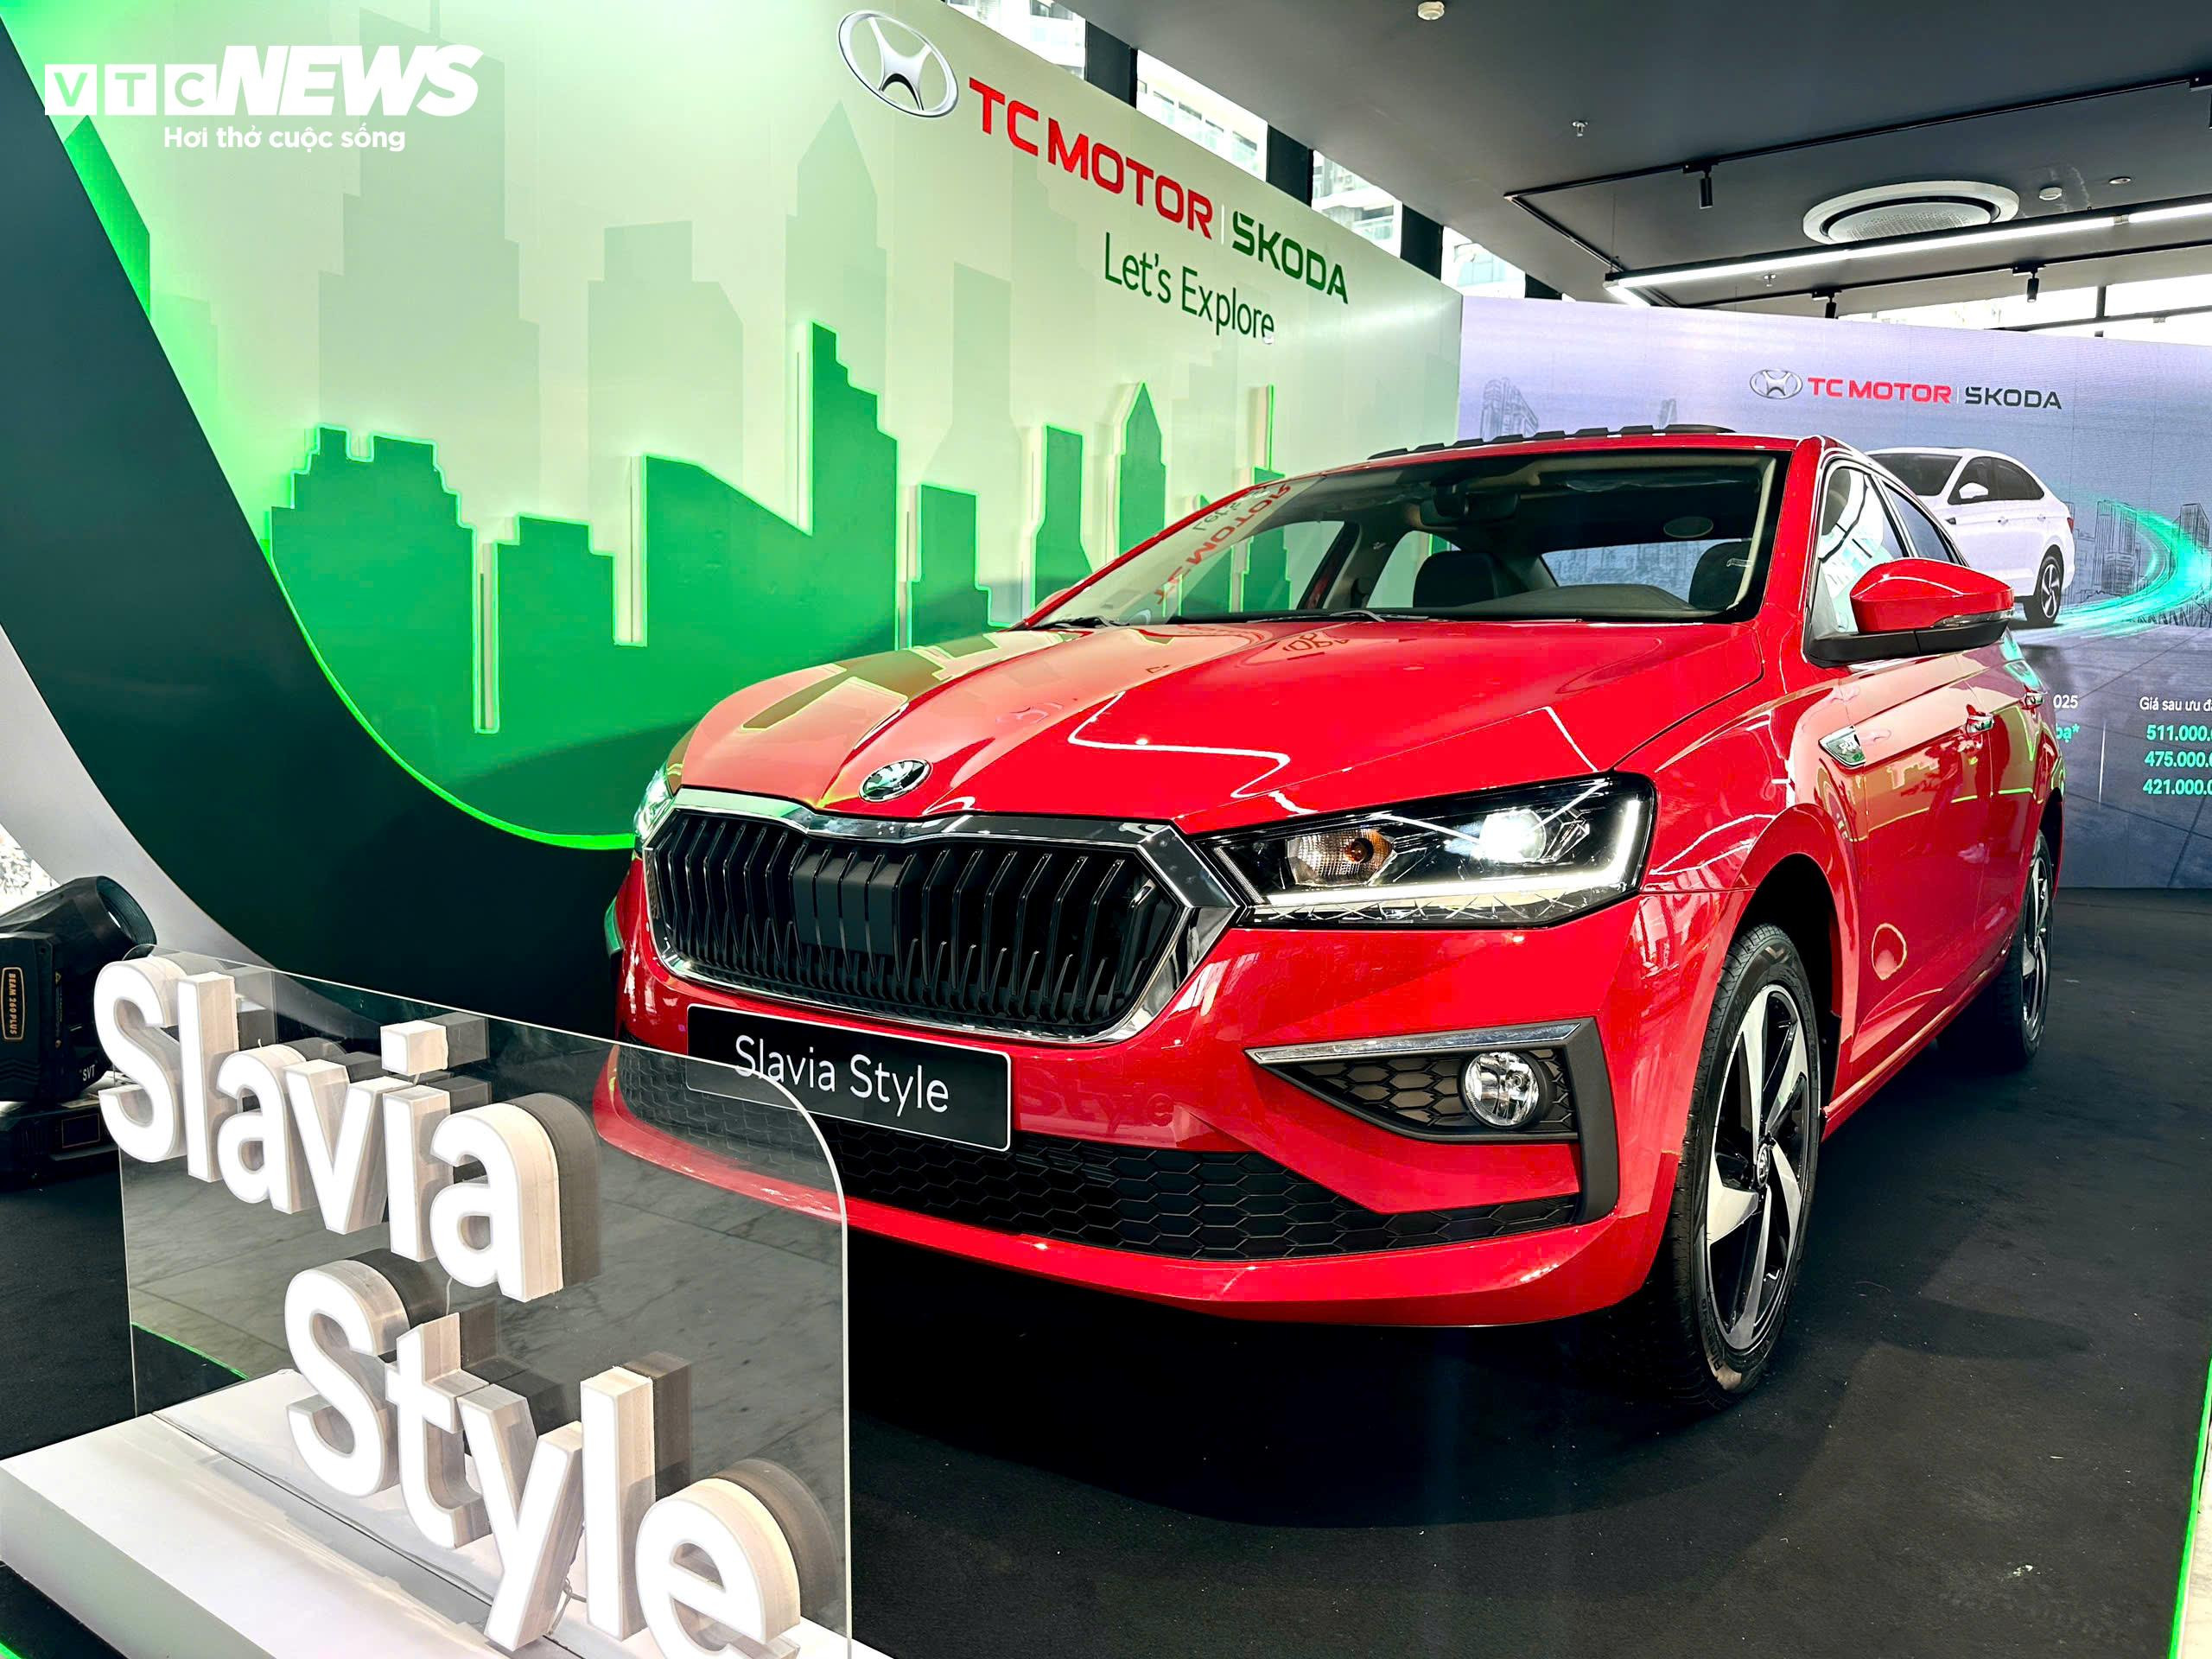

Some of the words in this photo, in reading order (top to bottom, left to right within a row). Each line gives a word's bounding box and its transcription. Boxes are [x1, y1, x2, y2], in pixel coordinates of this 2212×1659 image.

[969, 77, 1039, 156] TC
[1047, 117, 1212, 239] MOTOR
[1231, 210, 1349, 304] SKODA
[1105, 232, 1172, 303] Let's
[1182, 265, 1274, 340] Explore
[1808, 378, 1843, 397] TC
[1849, 380, 1952, 404] MOTOR
[1965, 386, 2063, 410] SKODA
[2053, 694, 2079, 709] 025
[2139, 696, 2159, 710] Giá
[2162, 700, 2183, 711] sau
[2185, 700, 2201, 711] ưu
[2203, 698, 2212, 711] đ
[2146, 724, 2212, 741] 511.000.
[9, 973, 17, 995] BEAM
[83, 1065, 95, 1081] SVT
[735, 1035, 836, 1091] Slavia
[850, 1054, 949, 1116] Style
[94, 957, 560, 1302] Slavia
[285, 1260, 800, 1659] Style
